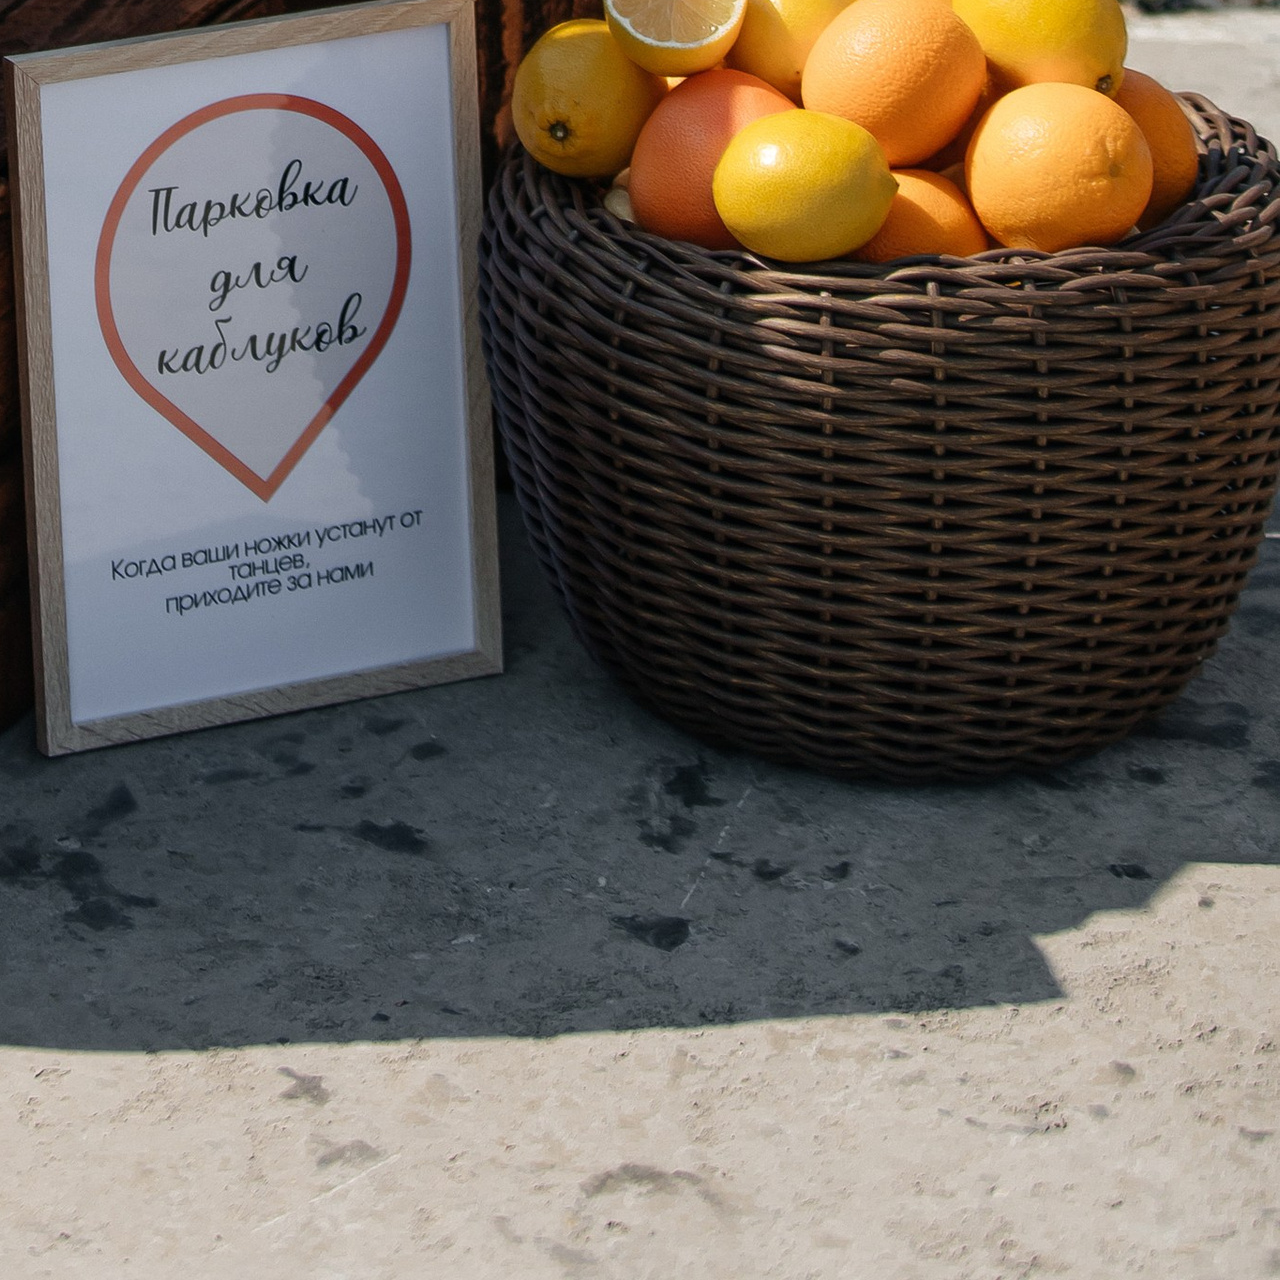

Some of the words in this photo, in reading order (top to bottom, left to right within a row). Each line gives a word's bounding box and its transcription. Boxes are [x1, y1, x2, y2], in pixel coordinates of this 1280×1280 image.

[148, 159, 358, 237] Парковка
[208, 255, 308, 311] для
[157, 292, 367, 375] каблуков
[111, 554, 176, 580] Когда
[181, 542, 240, 568] ваши
[244, 529, 311, 557] ножки
[314, 515, 396, 548] устанут
[400, 510, 424, 528] от
[228, 553, 311, 581] танцев,
[165, 578, 282, 616] приходите
[287, 572, 312, 590] за
[317, 561, 374, 586] нами
